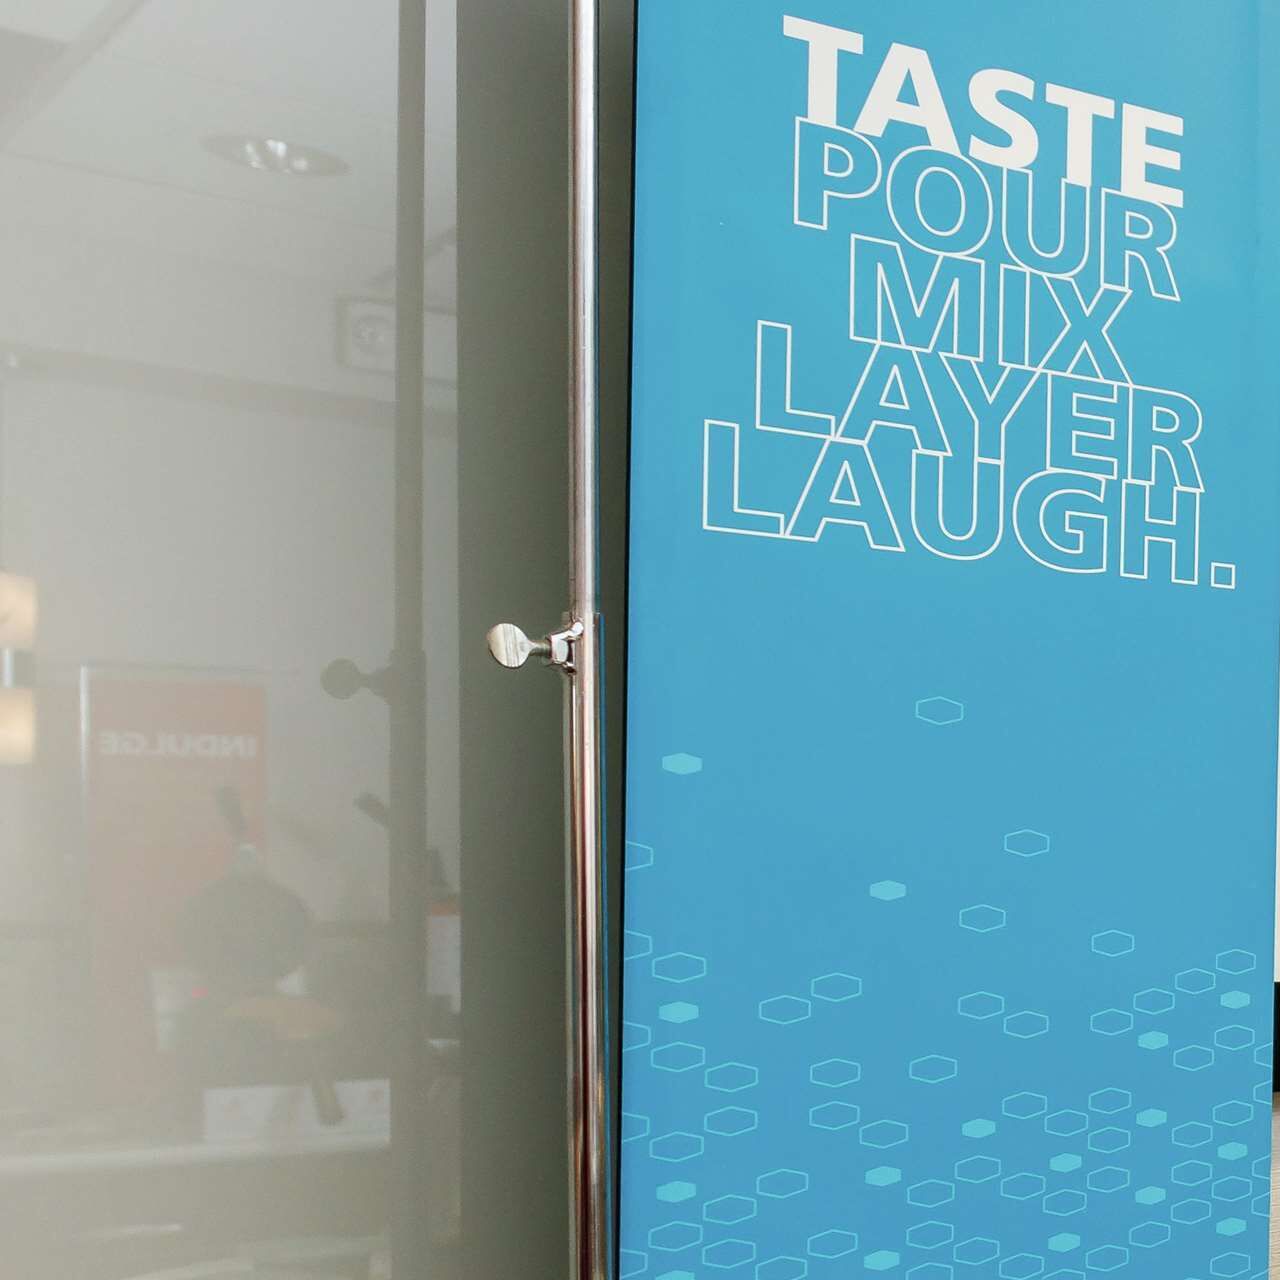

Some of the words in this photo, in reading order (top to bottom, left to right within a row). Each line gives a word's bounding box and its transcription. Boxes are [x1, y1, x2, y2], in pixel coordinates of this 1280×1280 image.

[782, 15, 1184, 208] TASTE
[794, 116, 1180, 301] POUR
[850, 233, 1133, 387] MIX
[756, 320, 1204, 492] LAYER
[703, 419, 1235, 589] LAUGH.
